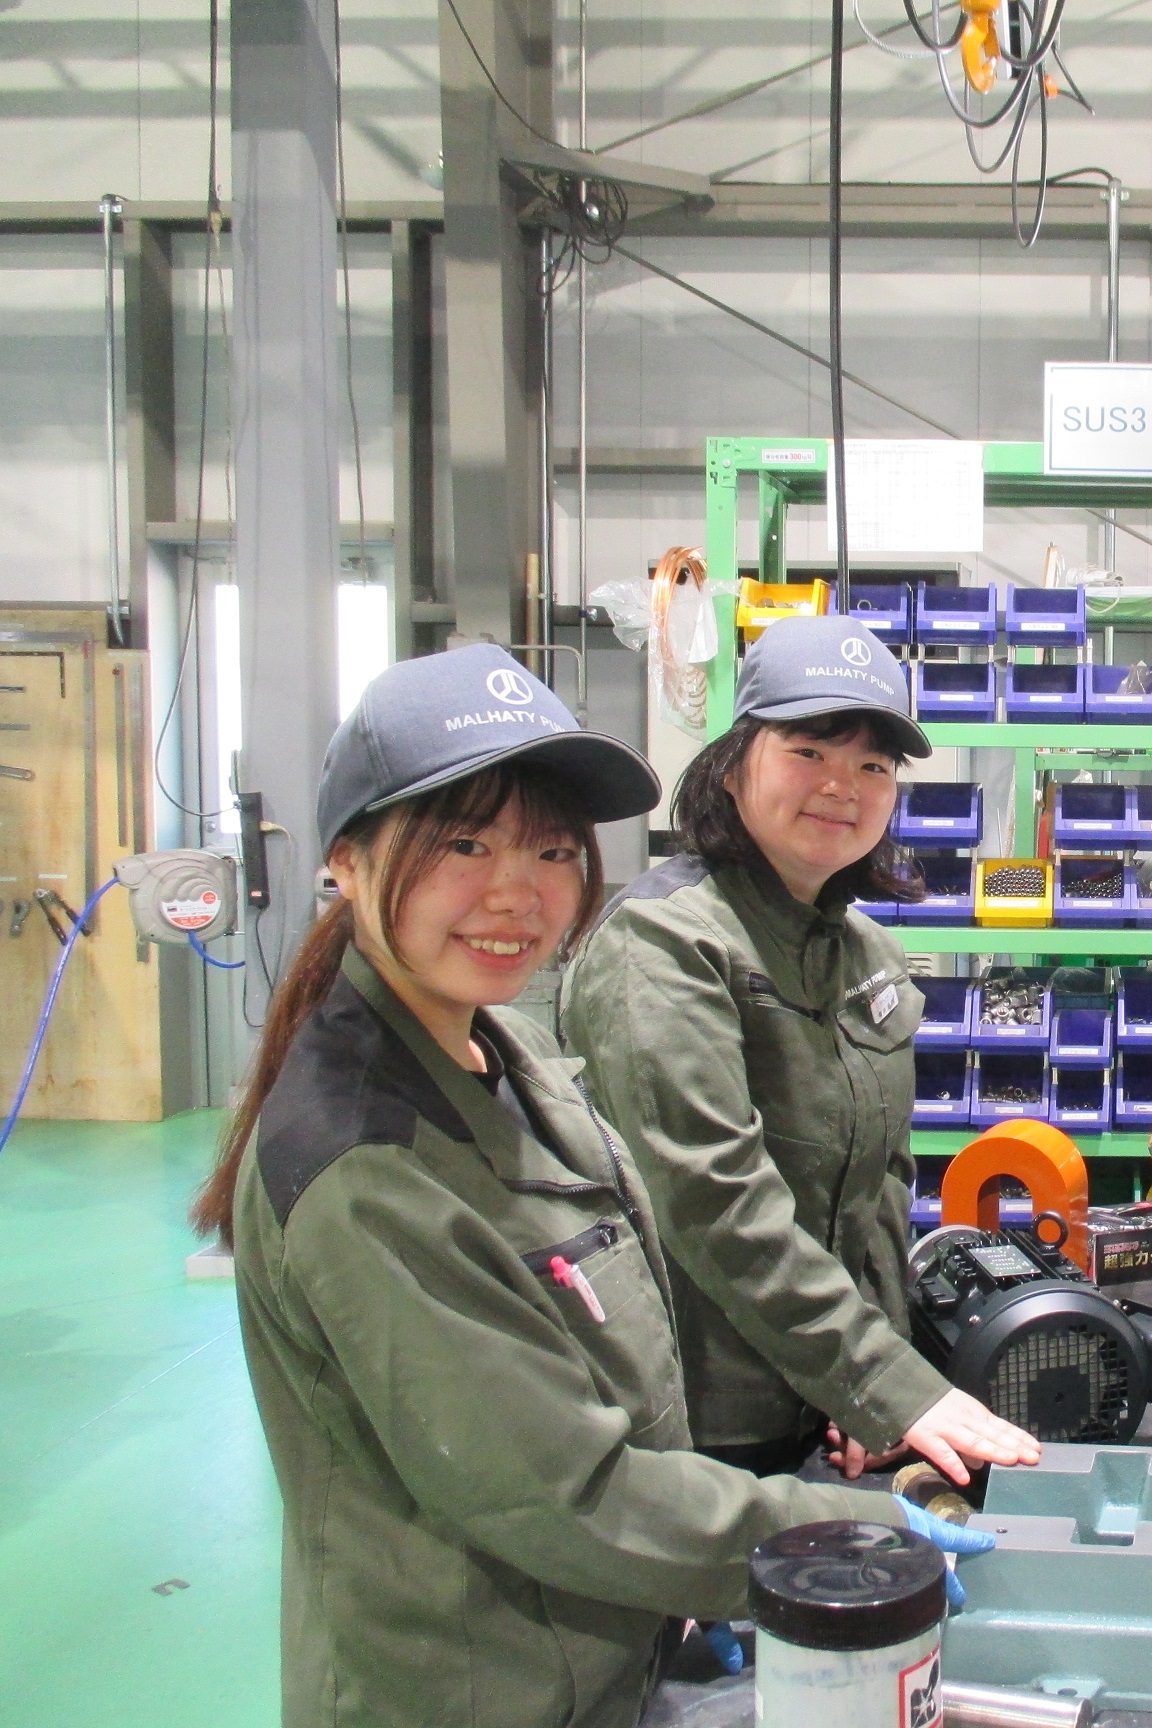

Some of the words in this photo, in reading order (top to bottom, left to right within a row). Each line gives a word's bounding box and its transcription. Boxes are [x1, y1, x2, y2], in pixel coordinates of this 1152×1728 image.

[805, 667, 867, 681] MALHATY
[870, 675, 895, 695] PUMP
[445, 710, 535, 731] MALHATY
